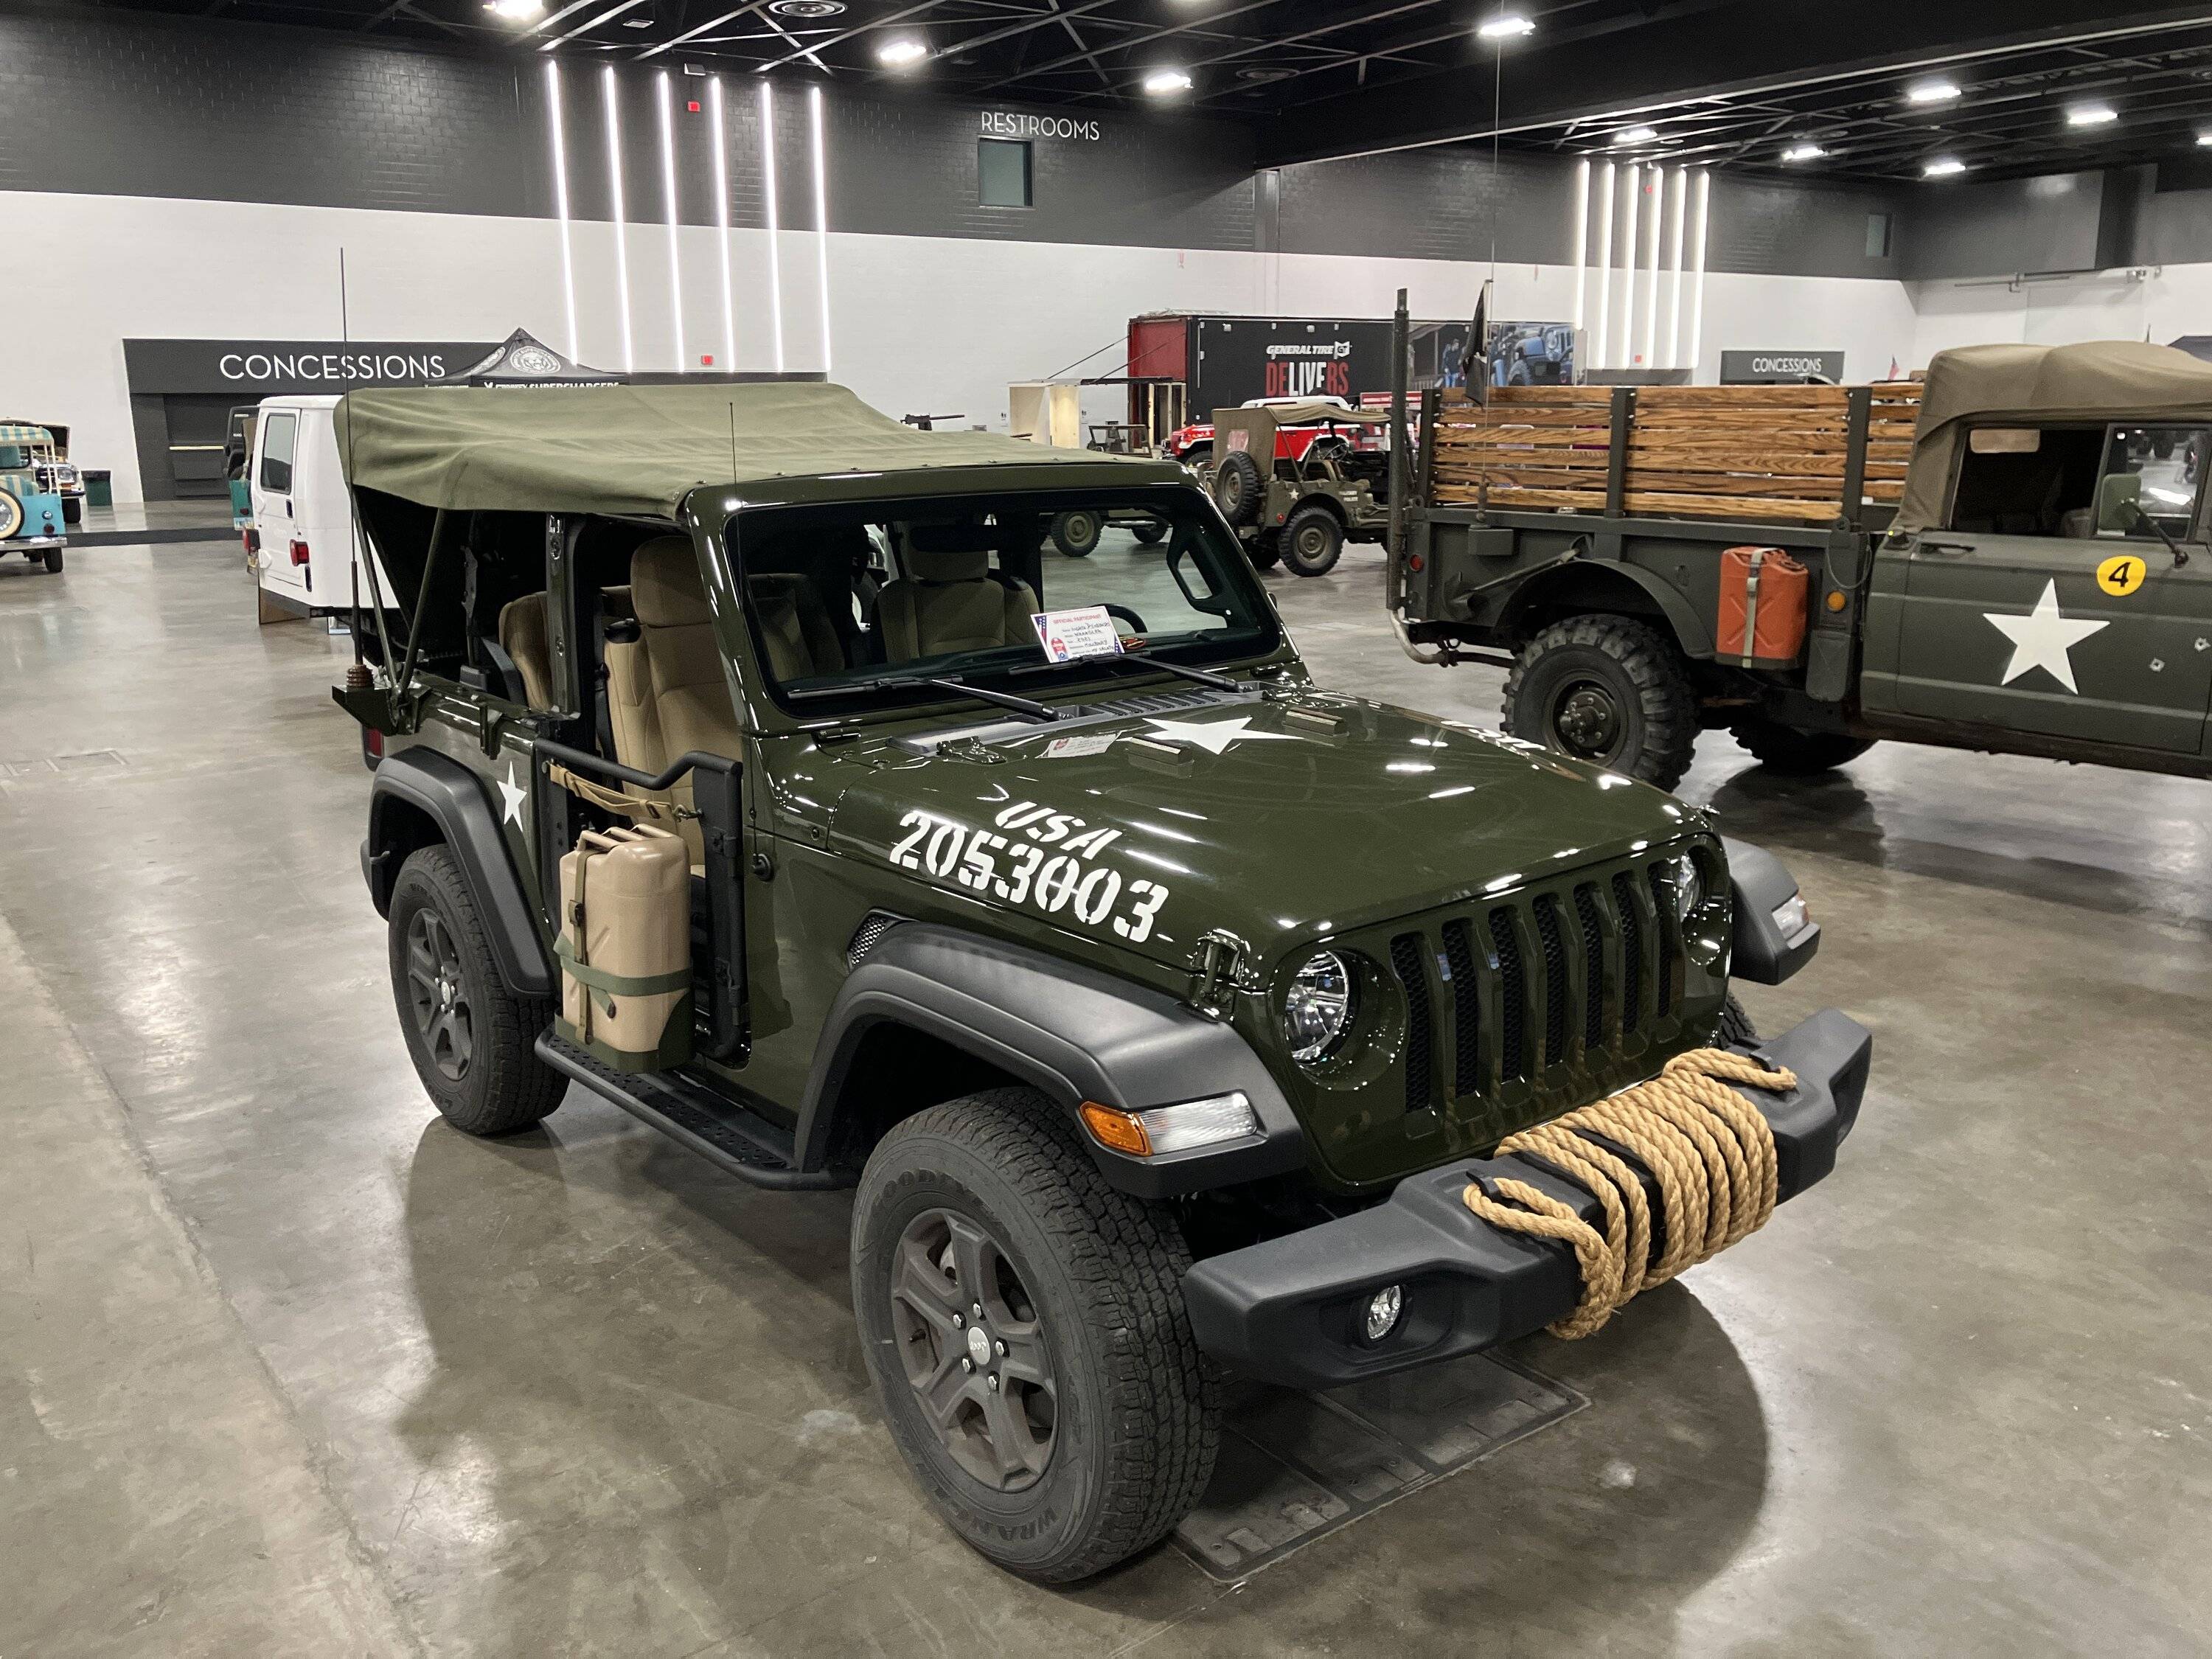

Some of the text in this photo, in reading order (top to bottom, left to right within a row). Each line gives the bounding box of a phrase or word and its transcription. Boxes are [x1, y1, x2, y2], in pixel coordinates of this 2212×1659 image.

[981, 111, 1099, 140] RESTROOMS
[1266, 345, 1334, 355] GENERAL TIRE
[220, 354, 445, 380] CONCESSIONS
[1265, 361, 1349, 397] DELIVERS
[1752, 358, 1822, 373] CONCESSIONS
[2108, 562, 2131, 588] 4
[995, 801, 1122, 860] USA
[889, 812, 1169, 943] 2053003
